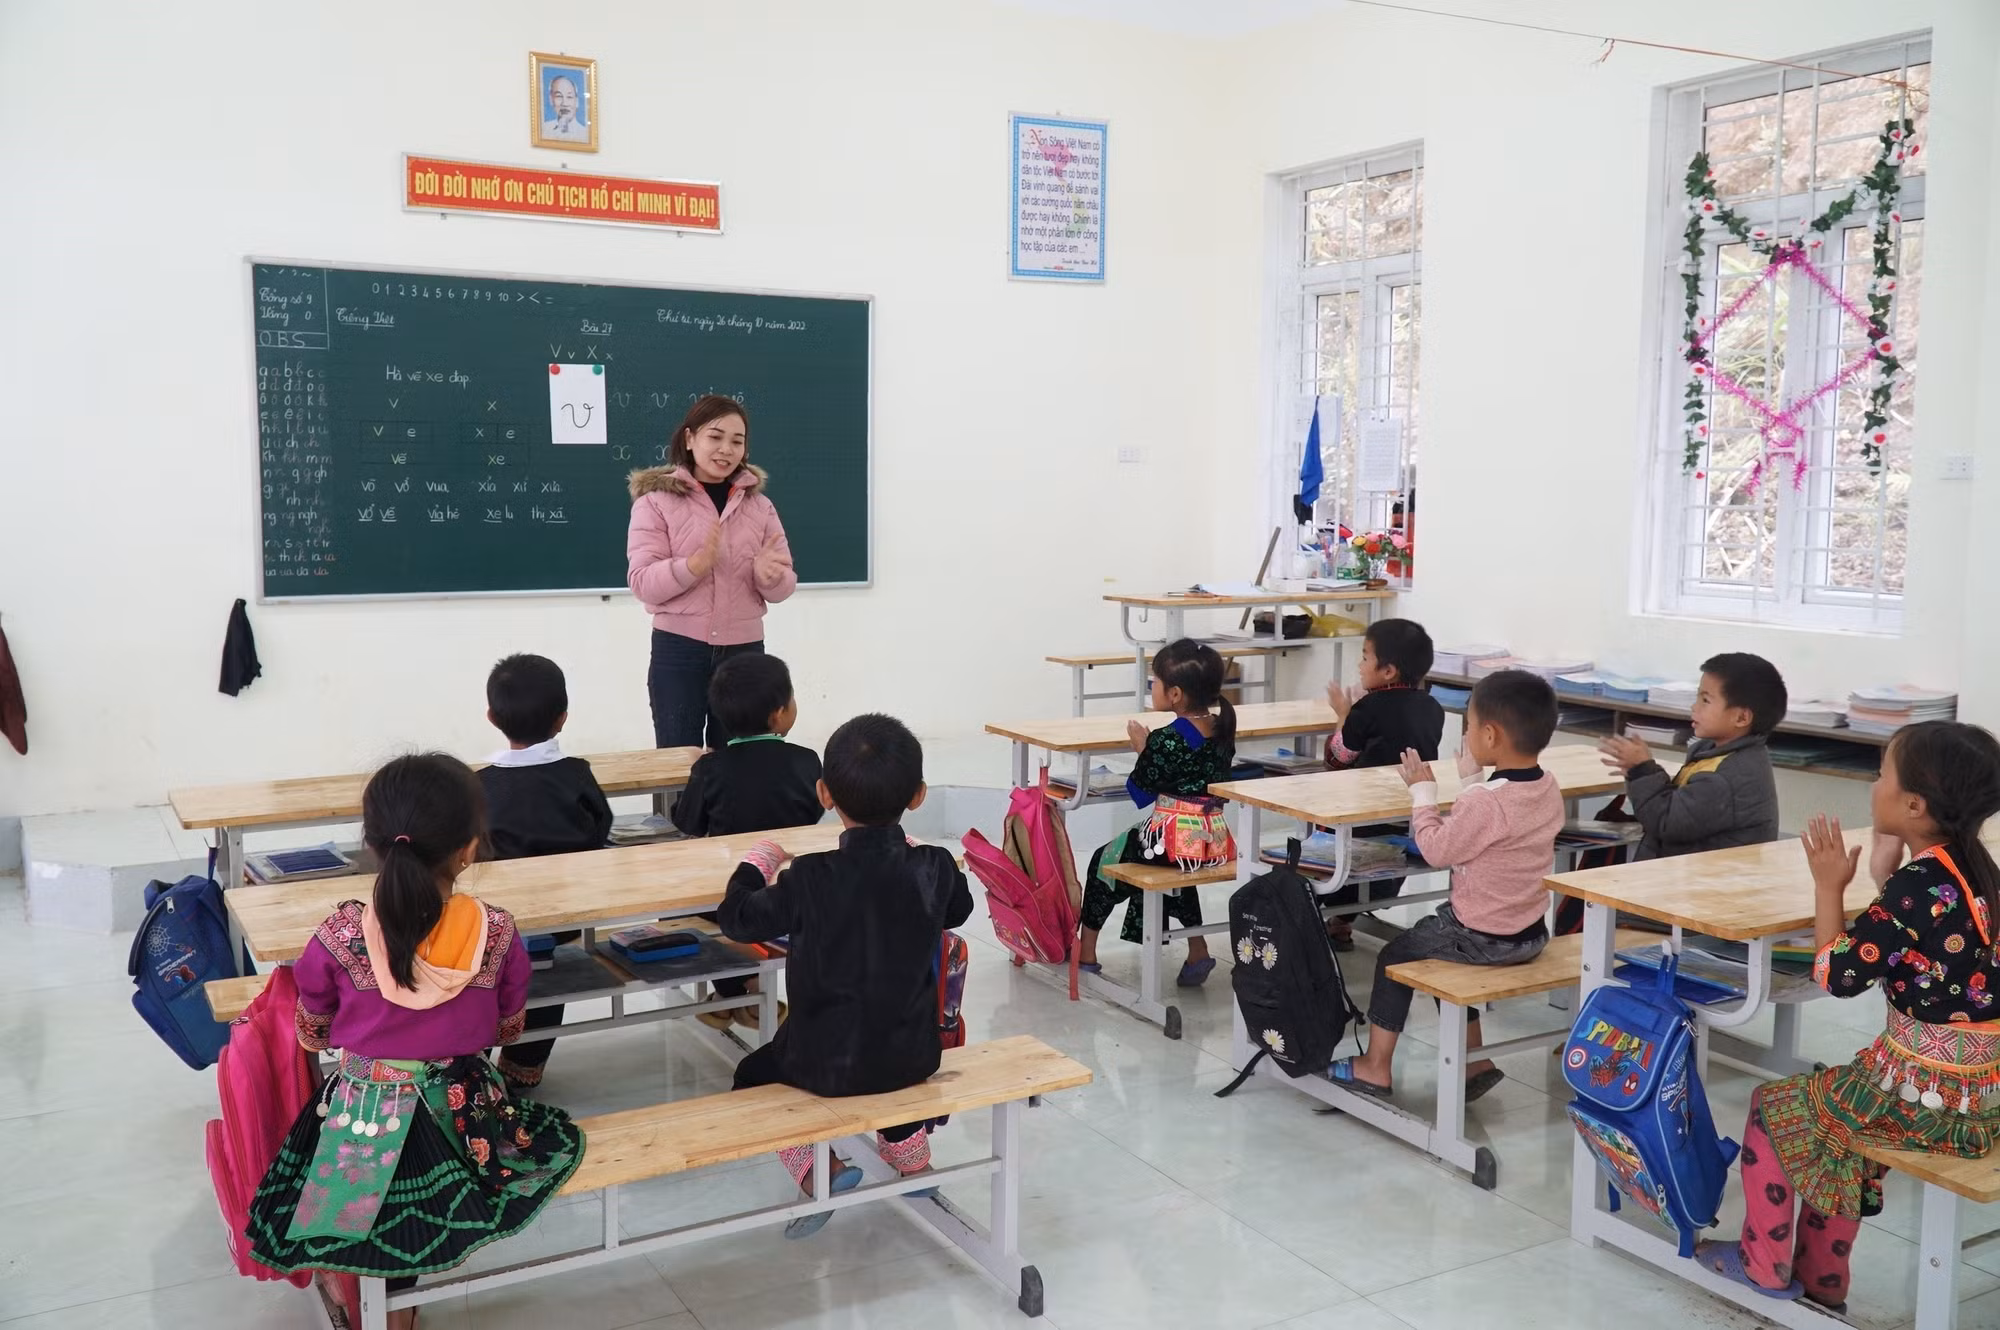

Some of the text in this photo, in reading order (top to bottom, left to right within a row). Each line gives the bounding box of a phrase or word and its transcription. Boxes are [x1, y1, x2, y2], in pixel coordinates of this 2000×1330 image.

[414, 167, 716, 223] ĐỜI ĐỜI NHỚ ƠN CHỦ TỊCH HỒ CHÍ MINH VĨ ĐẠI!
[372, 282, 510, 302] 0 1 2 3 4 5 6 7 8 9 10
[306, 294, 312, 305] 9
[304, 311, 312, 320] 0
[601, 322, 613, 334] 27
[694, 316, 715, 331] ngày
[716, 314, 726, 326] 26
[727, 314, 753, 334] tháng
[787, 319, 806, 331] 2022
[259, 360, 315, 378] a b c
[386, 364, 402, 381] Hà
[425, 372, 444, 383] xe
[560, 402, 595, 429] v
[407, 427, 416, 437] e
[505, 428, 516, 439] e
[487, 455, 505, 465] xe
[486, 508, 502, 519] xe
